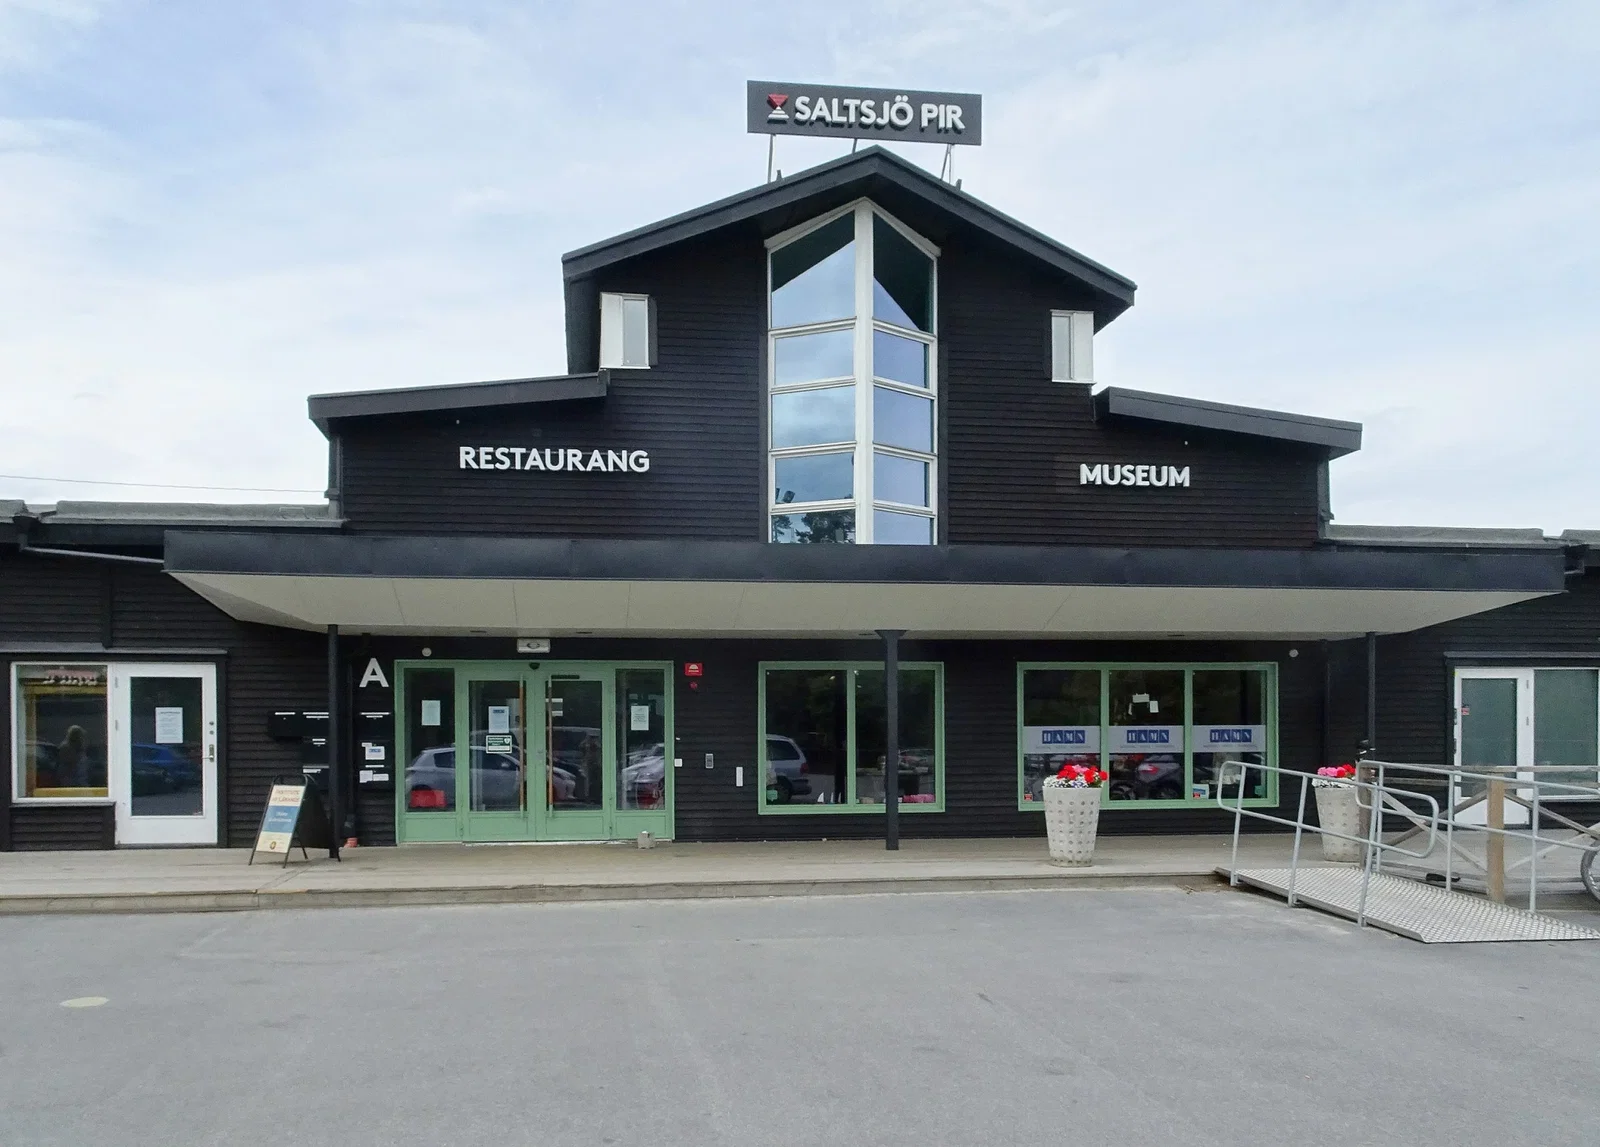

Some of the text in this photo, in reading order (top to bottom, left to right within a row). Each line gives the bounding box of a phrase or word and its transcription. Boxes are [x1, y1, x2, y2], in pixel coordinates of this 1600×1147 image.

[794, 95, 965, 130] SALTSJÖ PIR
[459, 446, 650, 473] RESTAURANG
[1080, 463, 1190, 487] MUSEUM
[359, 657, 389, 688] A
[1043, 732, 1085, 743] HAMN
[1128, 732, 1168, 742] HAMN
[1211, 731, 1251, 741] HAMN
